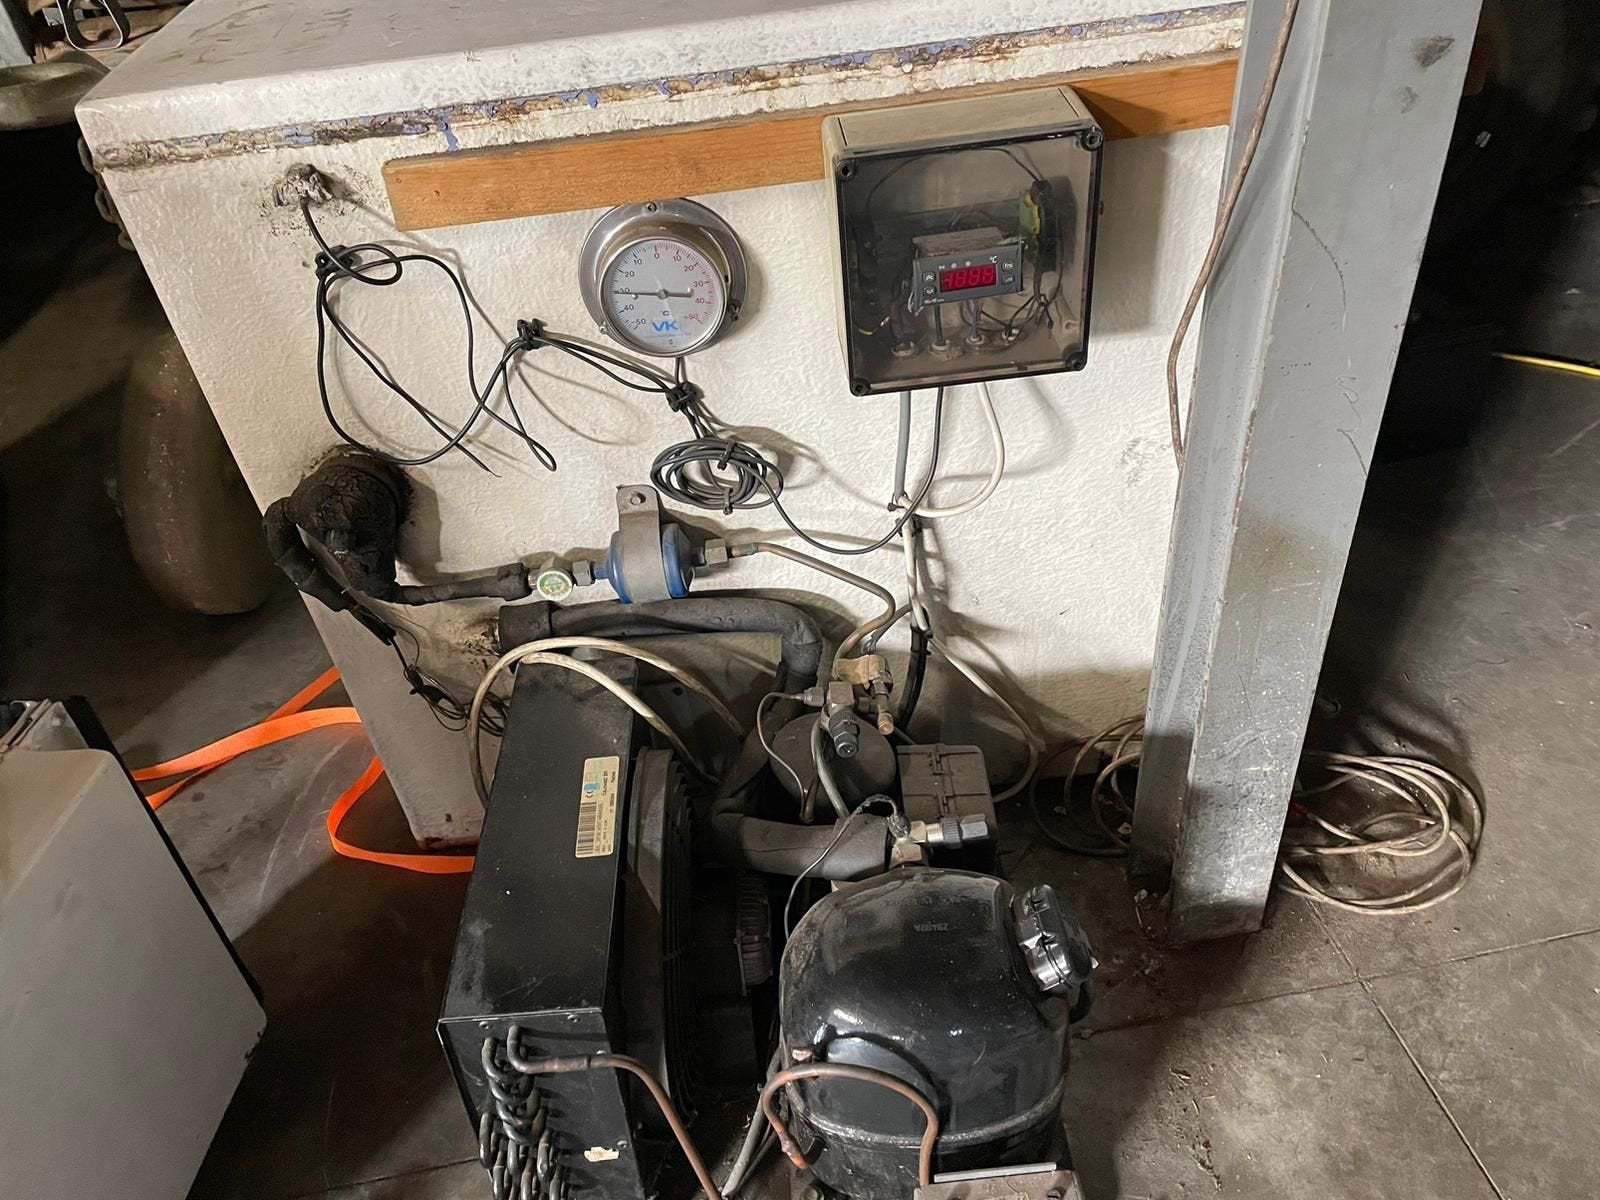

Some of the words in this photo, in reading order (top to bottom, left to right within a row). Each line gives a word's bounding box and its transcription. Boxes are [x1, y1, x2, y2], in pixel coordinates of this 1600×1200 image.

[693, 280, 704, 288] 30
[694, 297, 705, 305] 40
[623, 303, 635, 311] 40
[652, 320, 679, 332] VK
